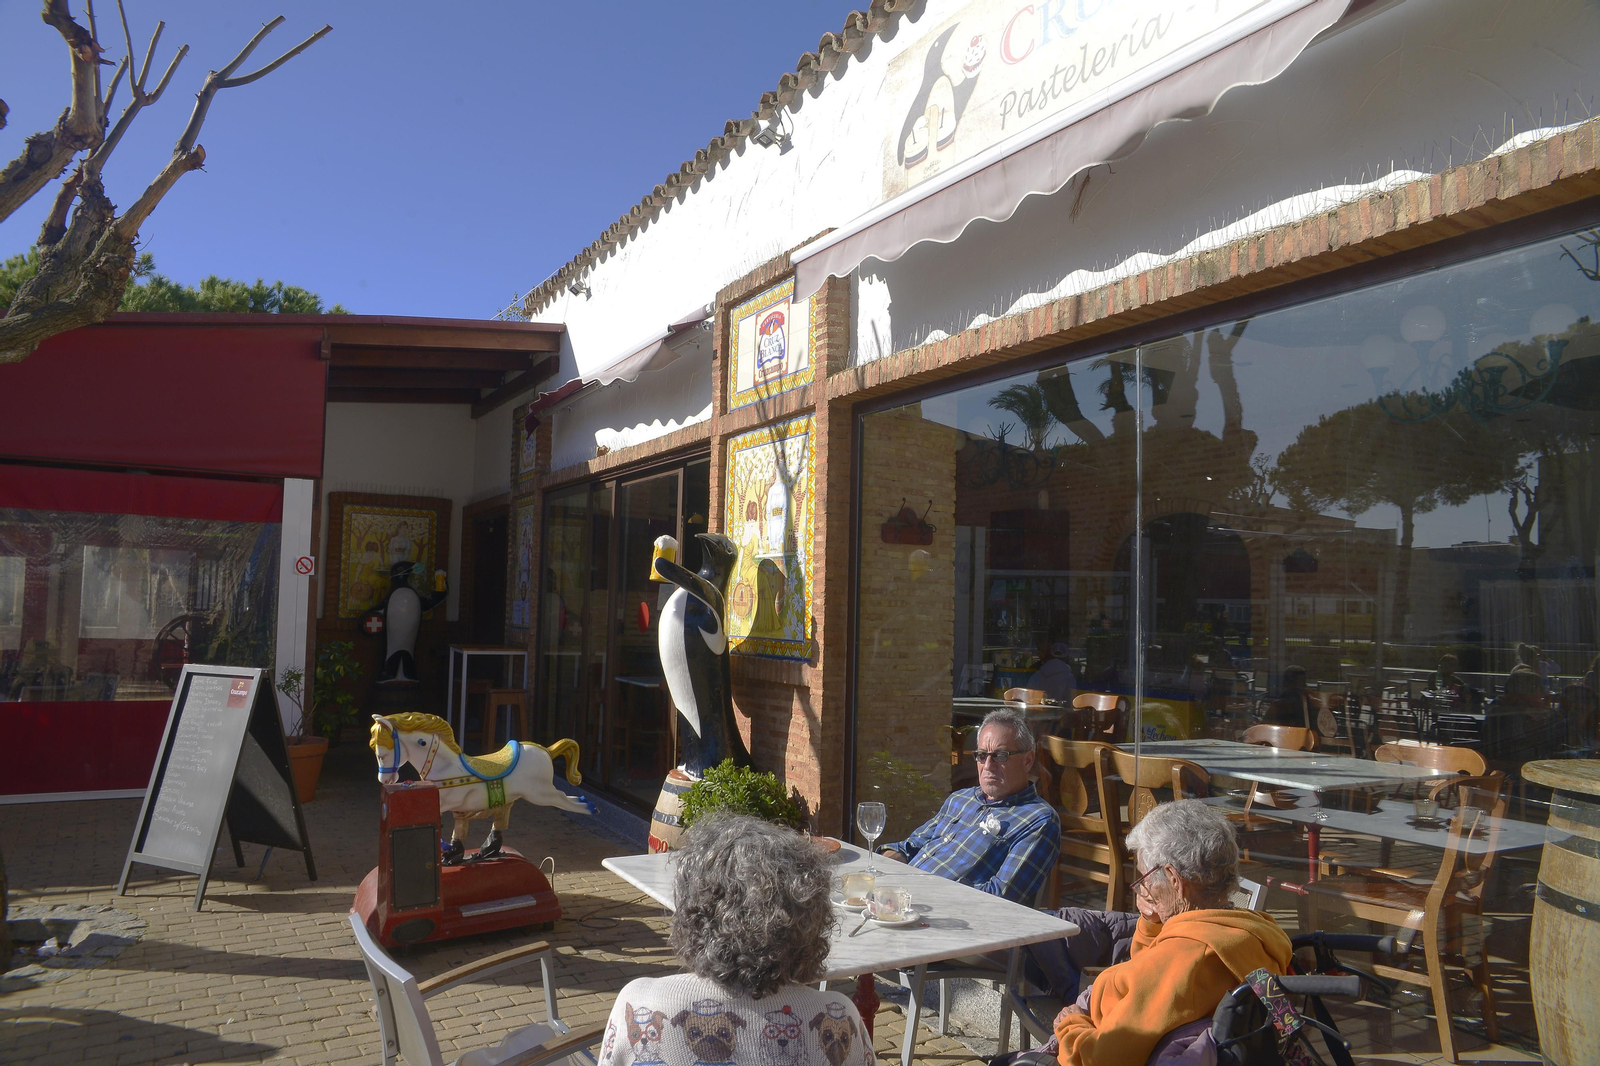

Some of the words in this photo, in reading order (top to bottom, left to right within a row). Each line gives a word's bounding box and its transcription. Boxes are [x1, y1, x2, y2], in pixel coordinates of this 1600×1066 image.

[999, 11, 1175, 130] Pastelería
[764, 334, 780, 348] CRUZ
[760, 343, 782, 358] BLANCA
[758, 363, 783, 378] Cruzcampo
